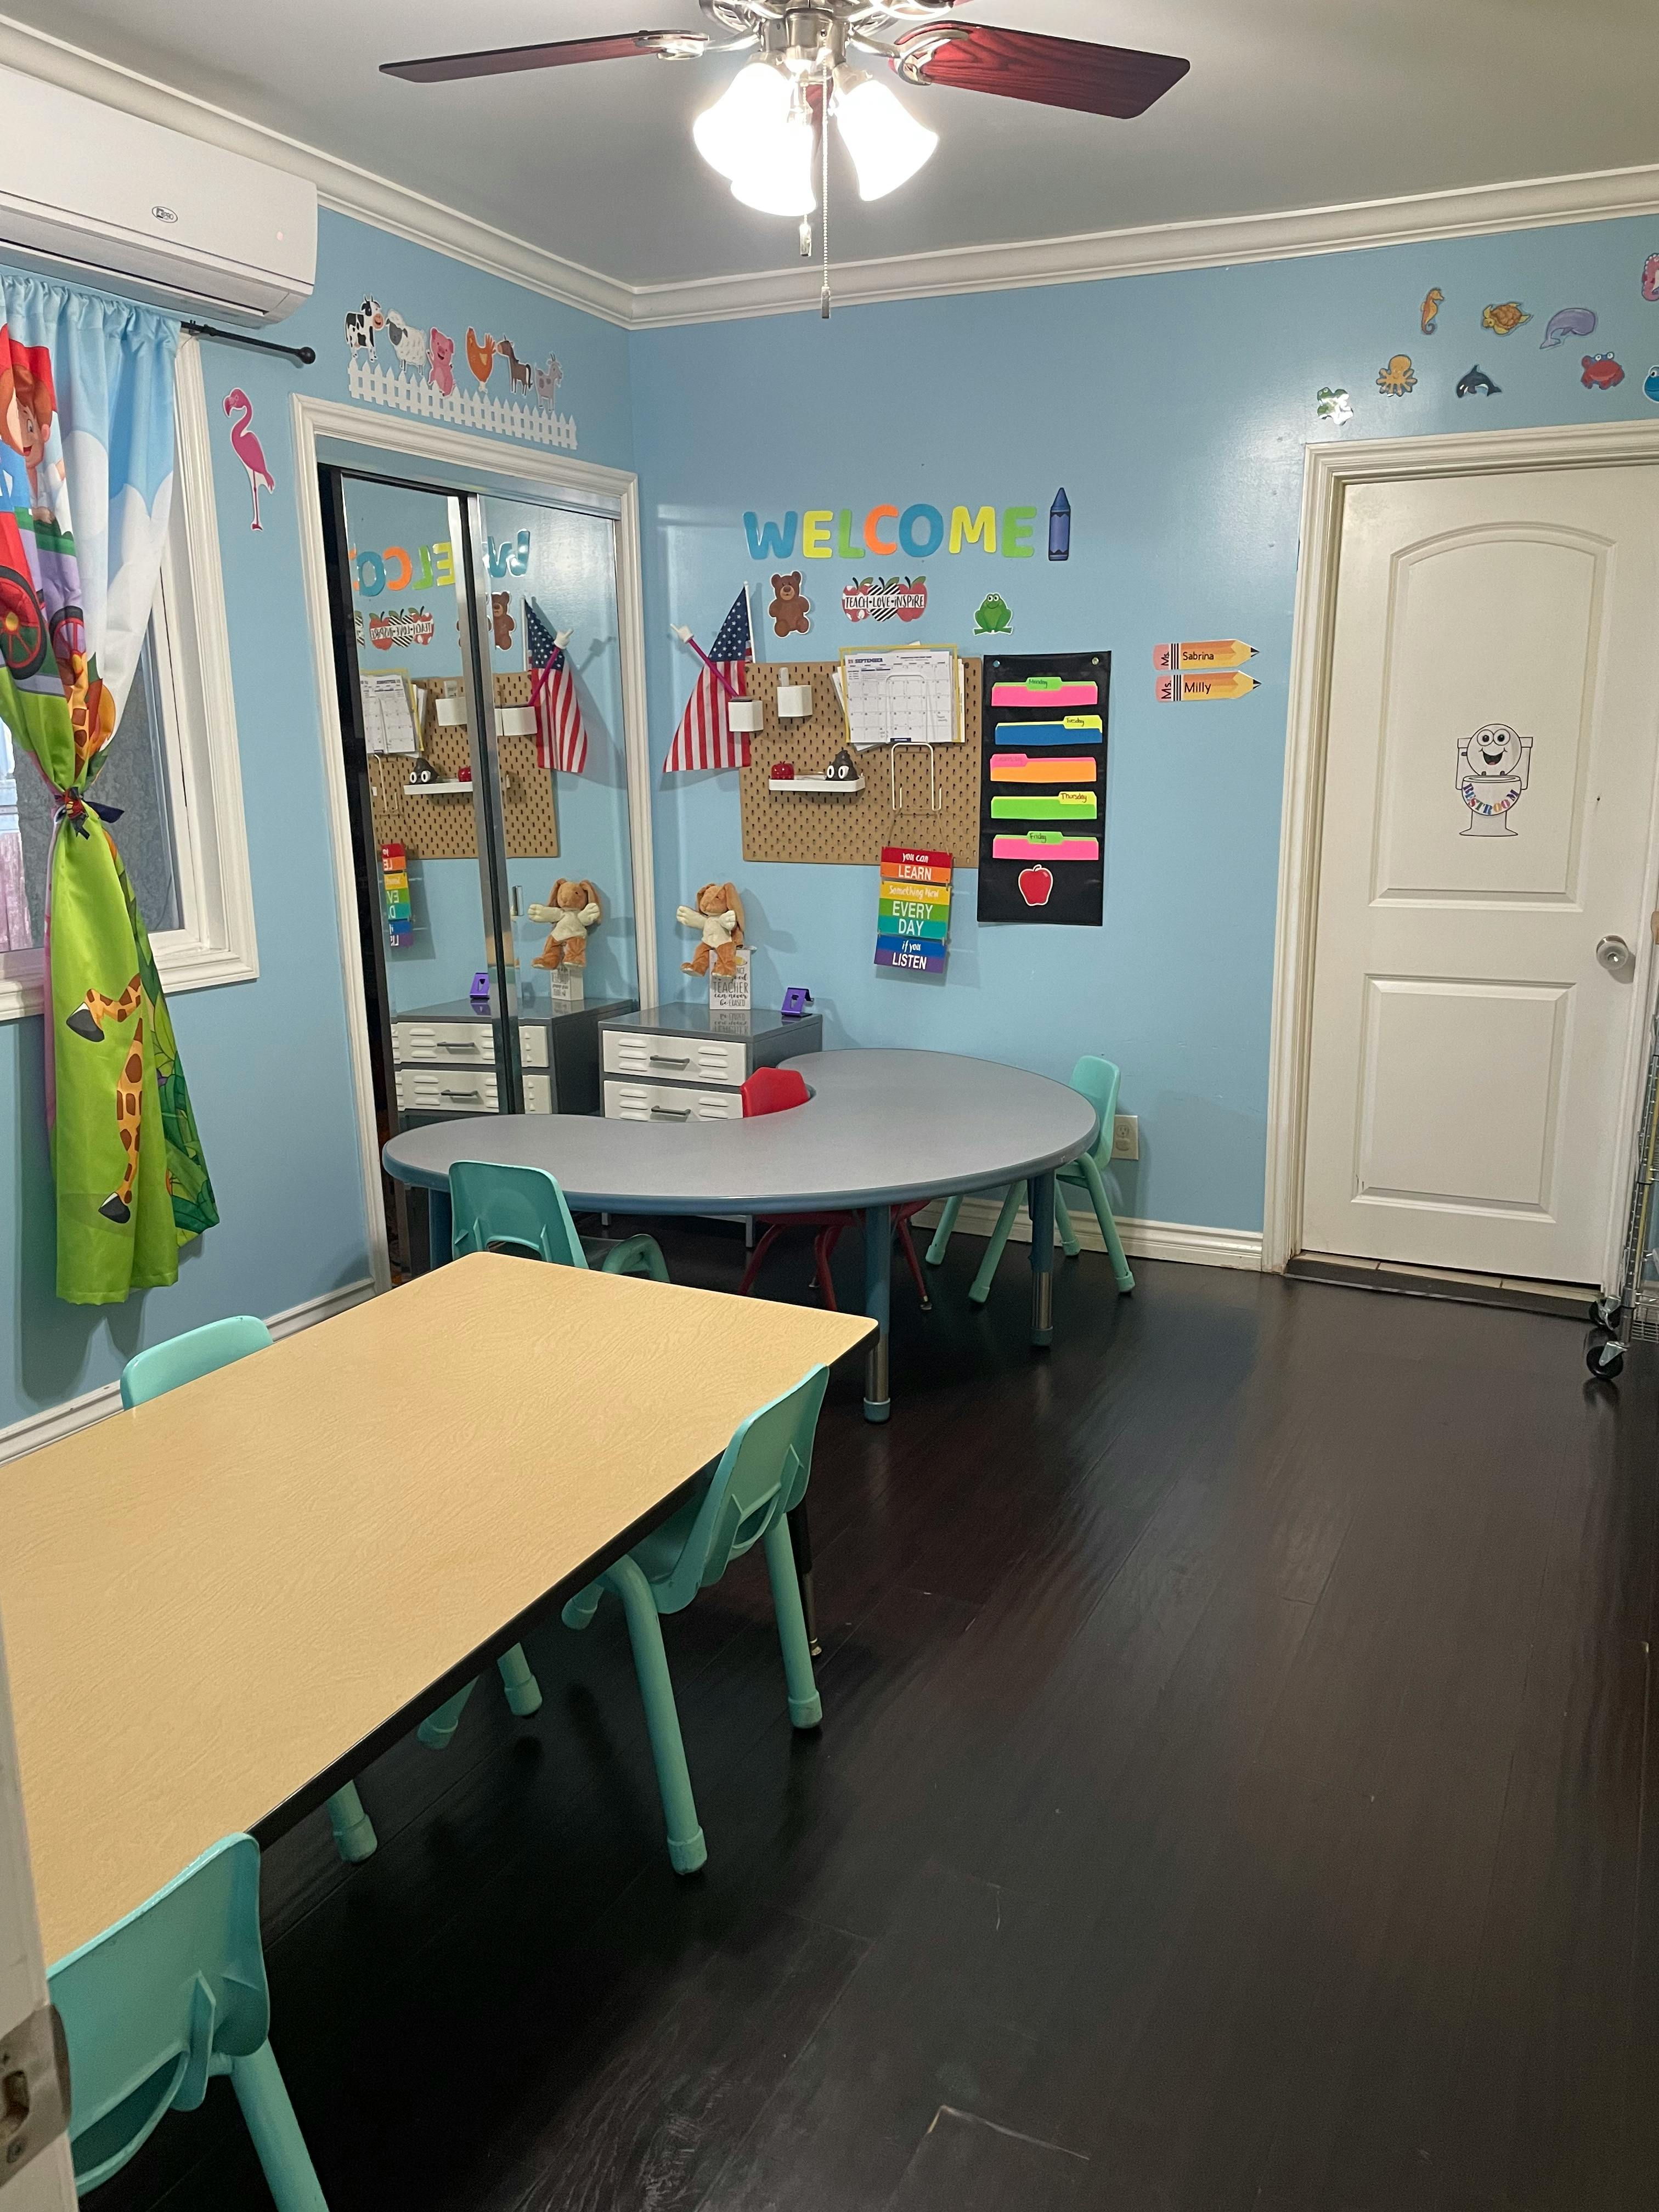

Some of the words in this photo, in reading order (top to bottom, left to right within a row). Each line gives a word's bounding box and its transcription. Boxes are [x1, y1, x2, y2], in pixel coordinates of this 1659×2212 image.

[743, 503, 1037, 560] WELCOME
[845, 596, 868, 608] TEACH
[873, 596, 891, 608] LOVE
[1183, 651, 1214, 661] Sabrina
[1029, 679, 1048, 689] Monday
[1184, 682, 1211, 695] Milly
[1066, 717, 1085, 727] Tuesday
[1060, 793, 1088, 803] Thursday
[1463, 783, 1520, 815] RESTROOM
[1029, 832, 1047, 843] Friday
[916, 855, 929, 863] can
[898, 865, 932, 881] LEARN
[893, 900, 933, 919] EVERY
[898, 918, 924, 936] DAY
[902, 940, 909, 953] if
[909, 943, 921, 953] you
[892, 952, 927, 969] LISTEN
[713, 981, 748, 994] TEACHER
